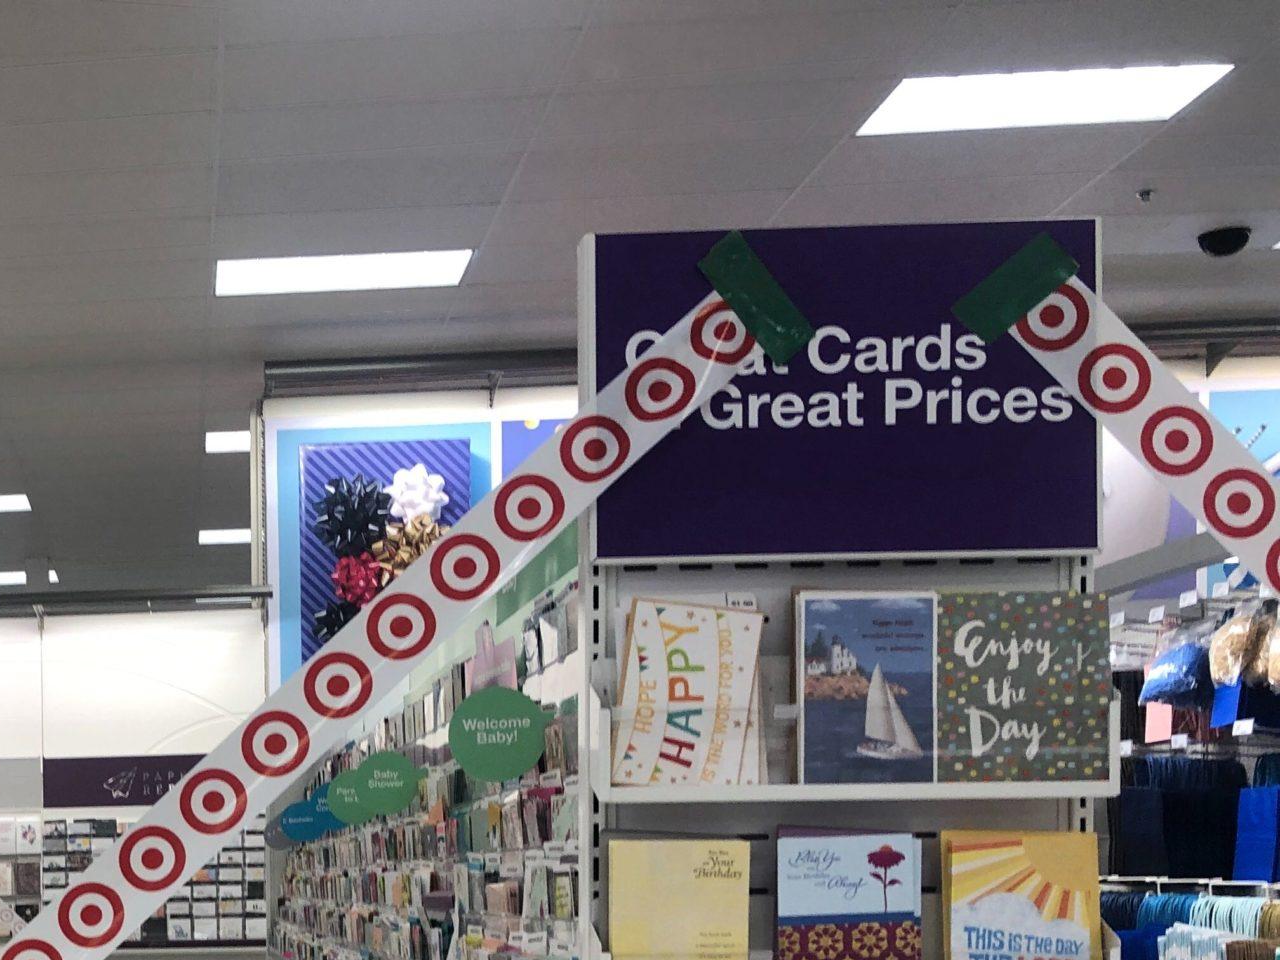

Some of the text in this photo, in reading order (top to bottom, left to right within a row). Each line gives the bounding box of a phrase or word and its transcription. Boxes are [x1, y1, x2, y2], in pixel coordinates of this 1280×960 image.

[807, 323, 987, 375] Cards
[702, 377, 1074, 429] Great Prices
[718, 628, 733, 657] YOU
[954, 619, 1059, 676] Enjoy
[718, 662, 733, 689] FOR
[659, 622, 705, 768] HAPPY
[983, 676, 1026, 709] the
[634, 680, 657, 734] HOPE
[715, 695, 732, 734] WORD
[462, 716, 531, 730] Welcome
[964, 705, 1047, 761] Day
[476, 730, 518, 746] Baby!
[708, 741, 724, 766] THE
[368, 779, 404, 789] Shower
[374, 770, 399, 781] Baby
[694, 866, 743, 880] Birthday
[710, 857, 734, 869] Your
[964, 926, 1004, 950] THIS
